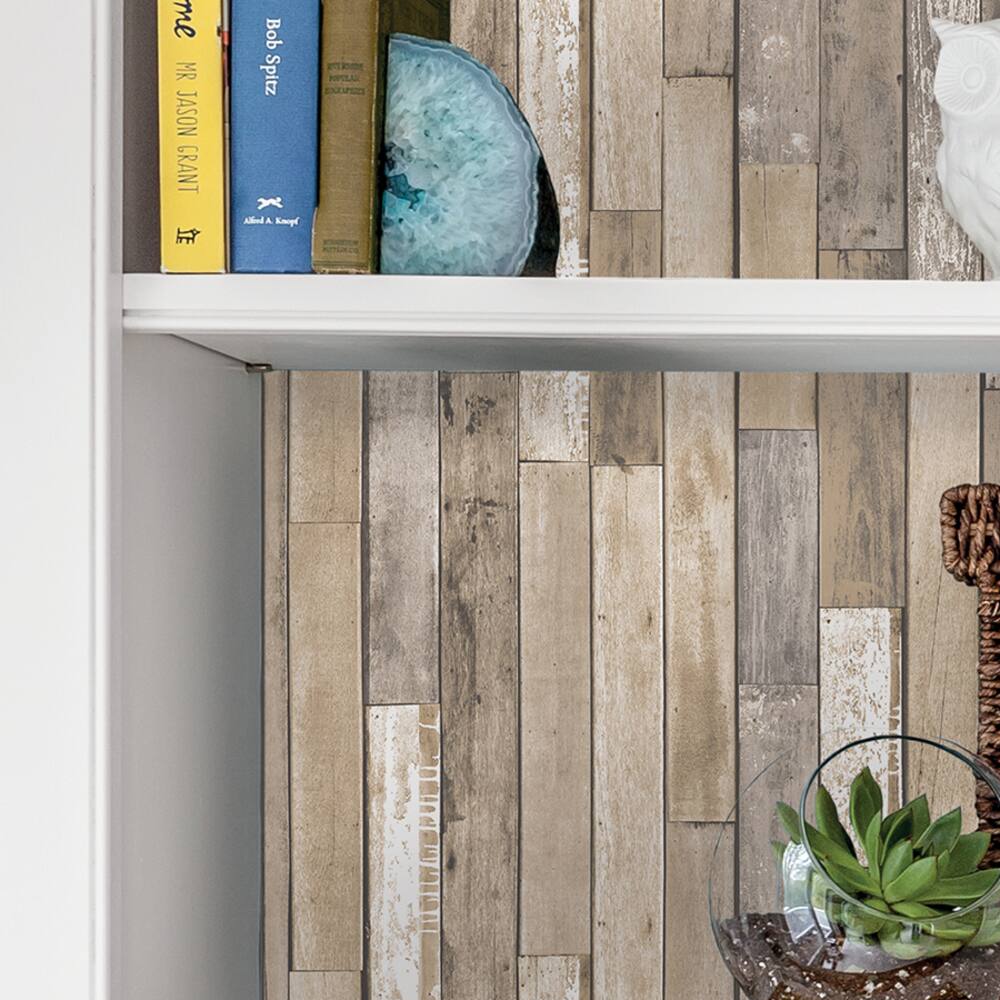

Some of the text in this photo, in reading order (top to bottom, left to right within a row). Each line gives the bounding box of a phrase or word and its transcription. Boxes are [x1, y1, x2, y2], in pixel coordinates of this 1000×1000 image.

[260, 18, 283, 96] Bob Spitz
[175, 62, 199, 194] MR JASON GRANT
[243, 216, 300, 227] Alfred A. Knopf
